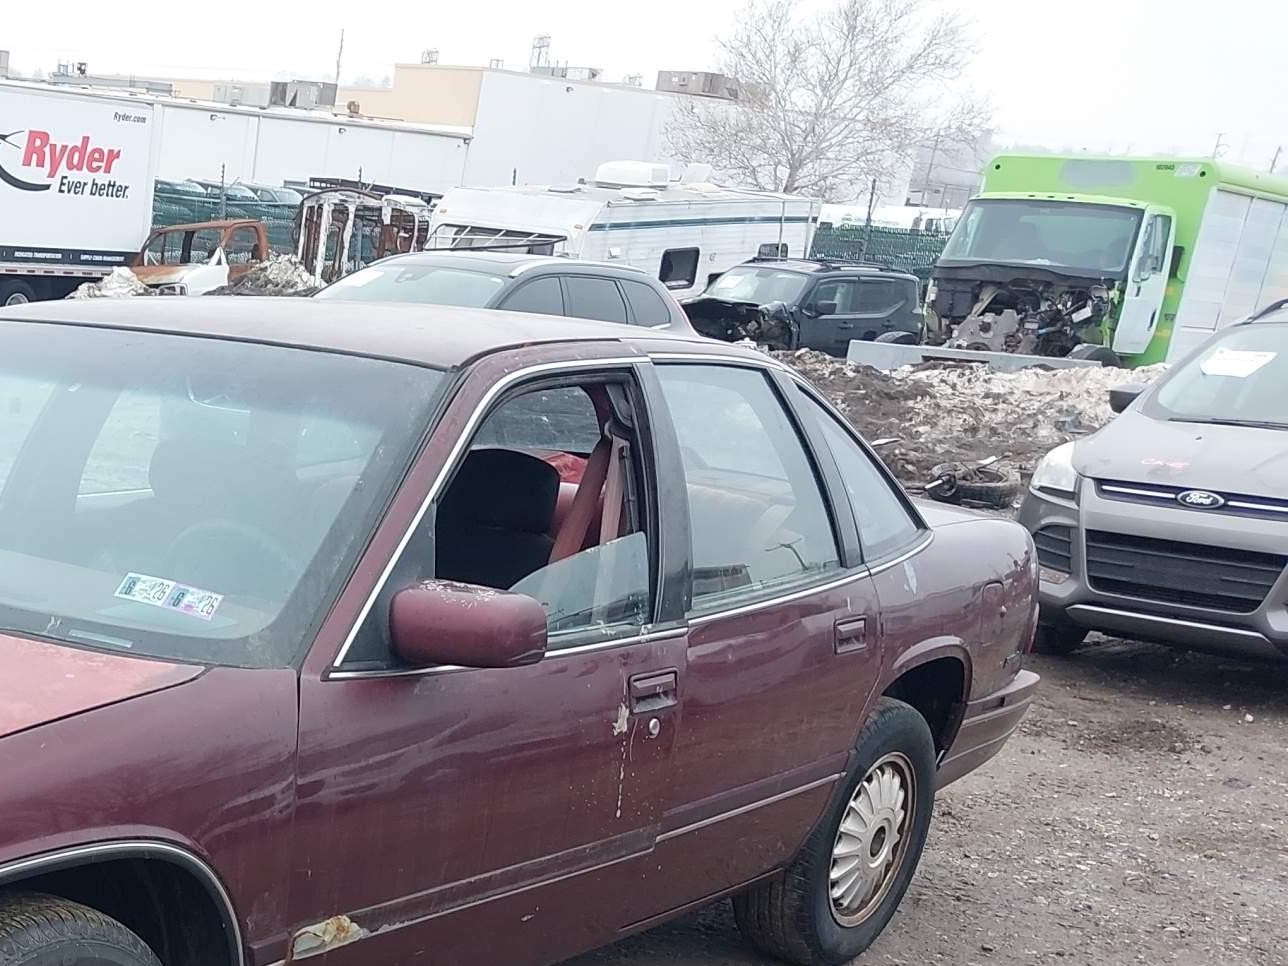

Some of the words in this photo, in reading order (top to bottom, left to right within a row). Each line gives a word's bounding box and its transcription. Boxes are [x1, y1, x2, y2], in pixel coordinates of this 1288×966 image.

[113, 111, 147, 124] Ryder.com
[22, 130, 121, 178] Ryder
[58, 175, 88, 196] Ever
[90, 178, 129, 199] better.
[1185, 491, 1214, 505] Ford
[152, 582, 170, 601] 26
[172, 591, 185, 607] 6
[200, 595, 218, 615] 26
